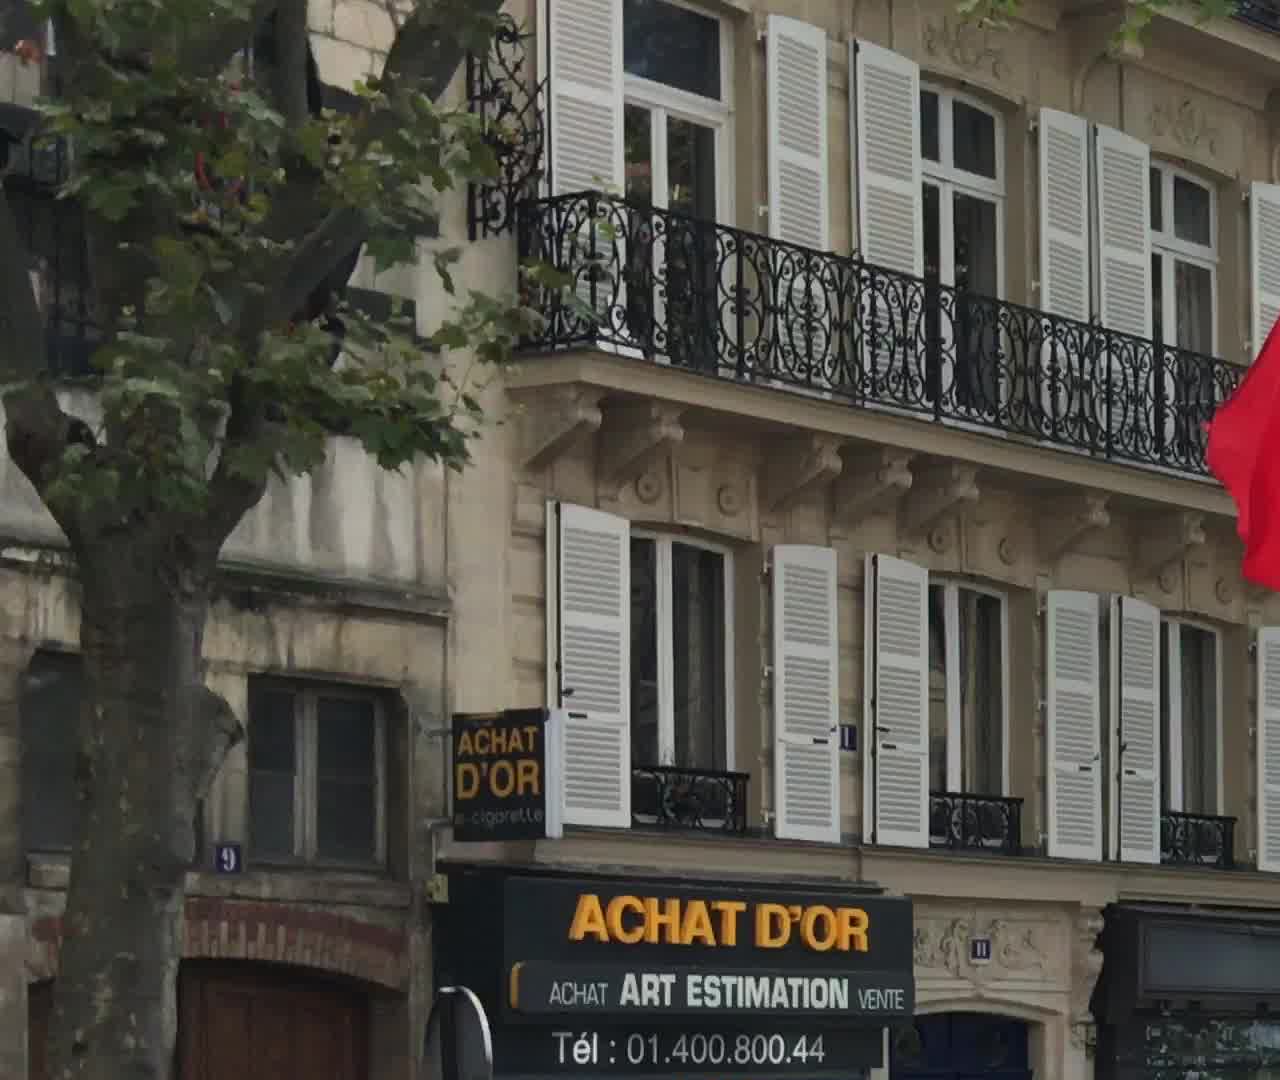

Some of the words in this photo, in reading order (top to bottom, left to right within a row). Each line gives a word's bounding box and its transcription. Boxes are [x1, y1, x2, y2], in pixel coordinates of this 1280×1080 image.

[457, 727, 540, 755] ACHAT
[456, 758, 541, 800] D'OR
[222, 847, 236, 872] 9
[568, 893, 747, 948] ACHAT
[753, 902, 872, 953] D'OR
[549, 981, 608, 1006] ACHAT
[619, 973, 677, 1006] ART
[686, 974, 849, 1010] ESTIMATION
[857, 988, 905, 1010] VENTE
[552, 1031, 599, 1064] Tél
[626, 1032, 826, 1065] 01.400.800.44
